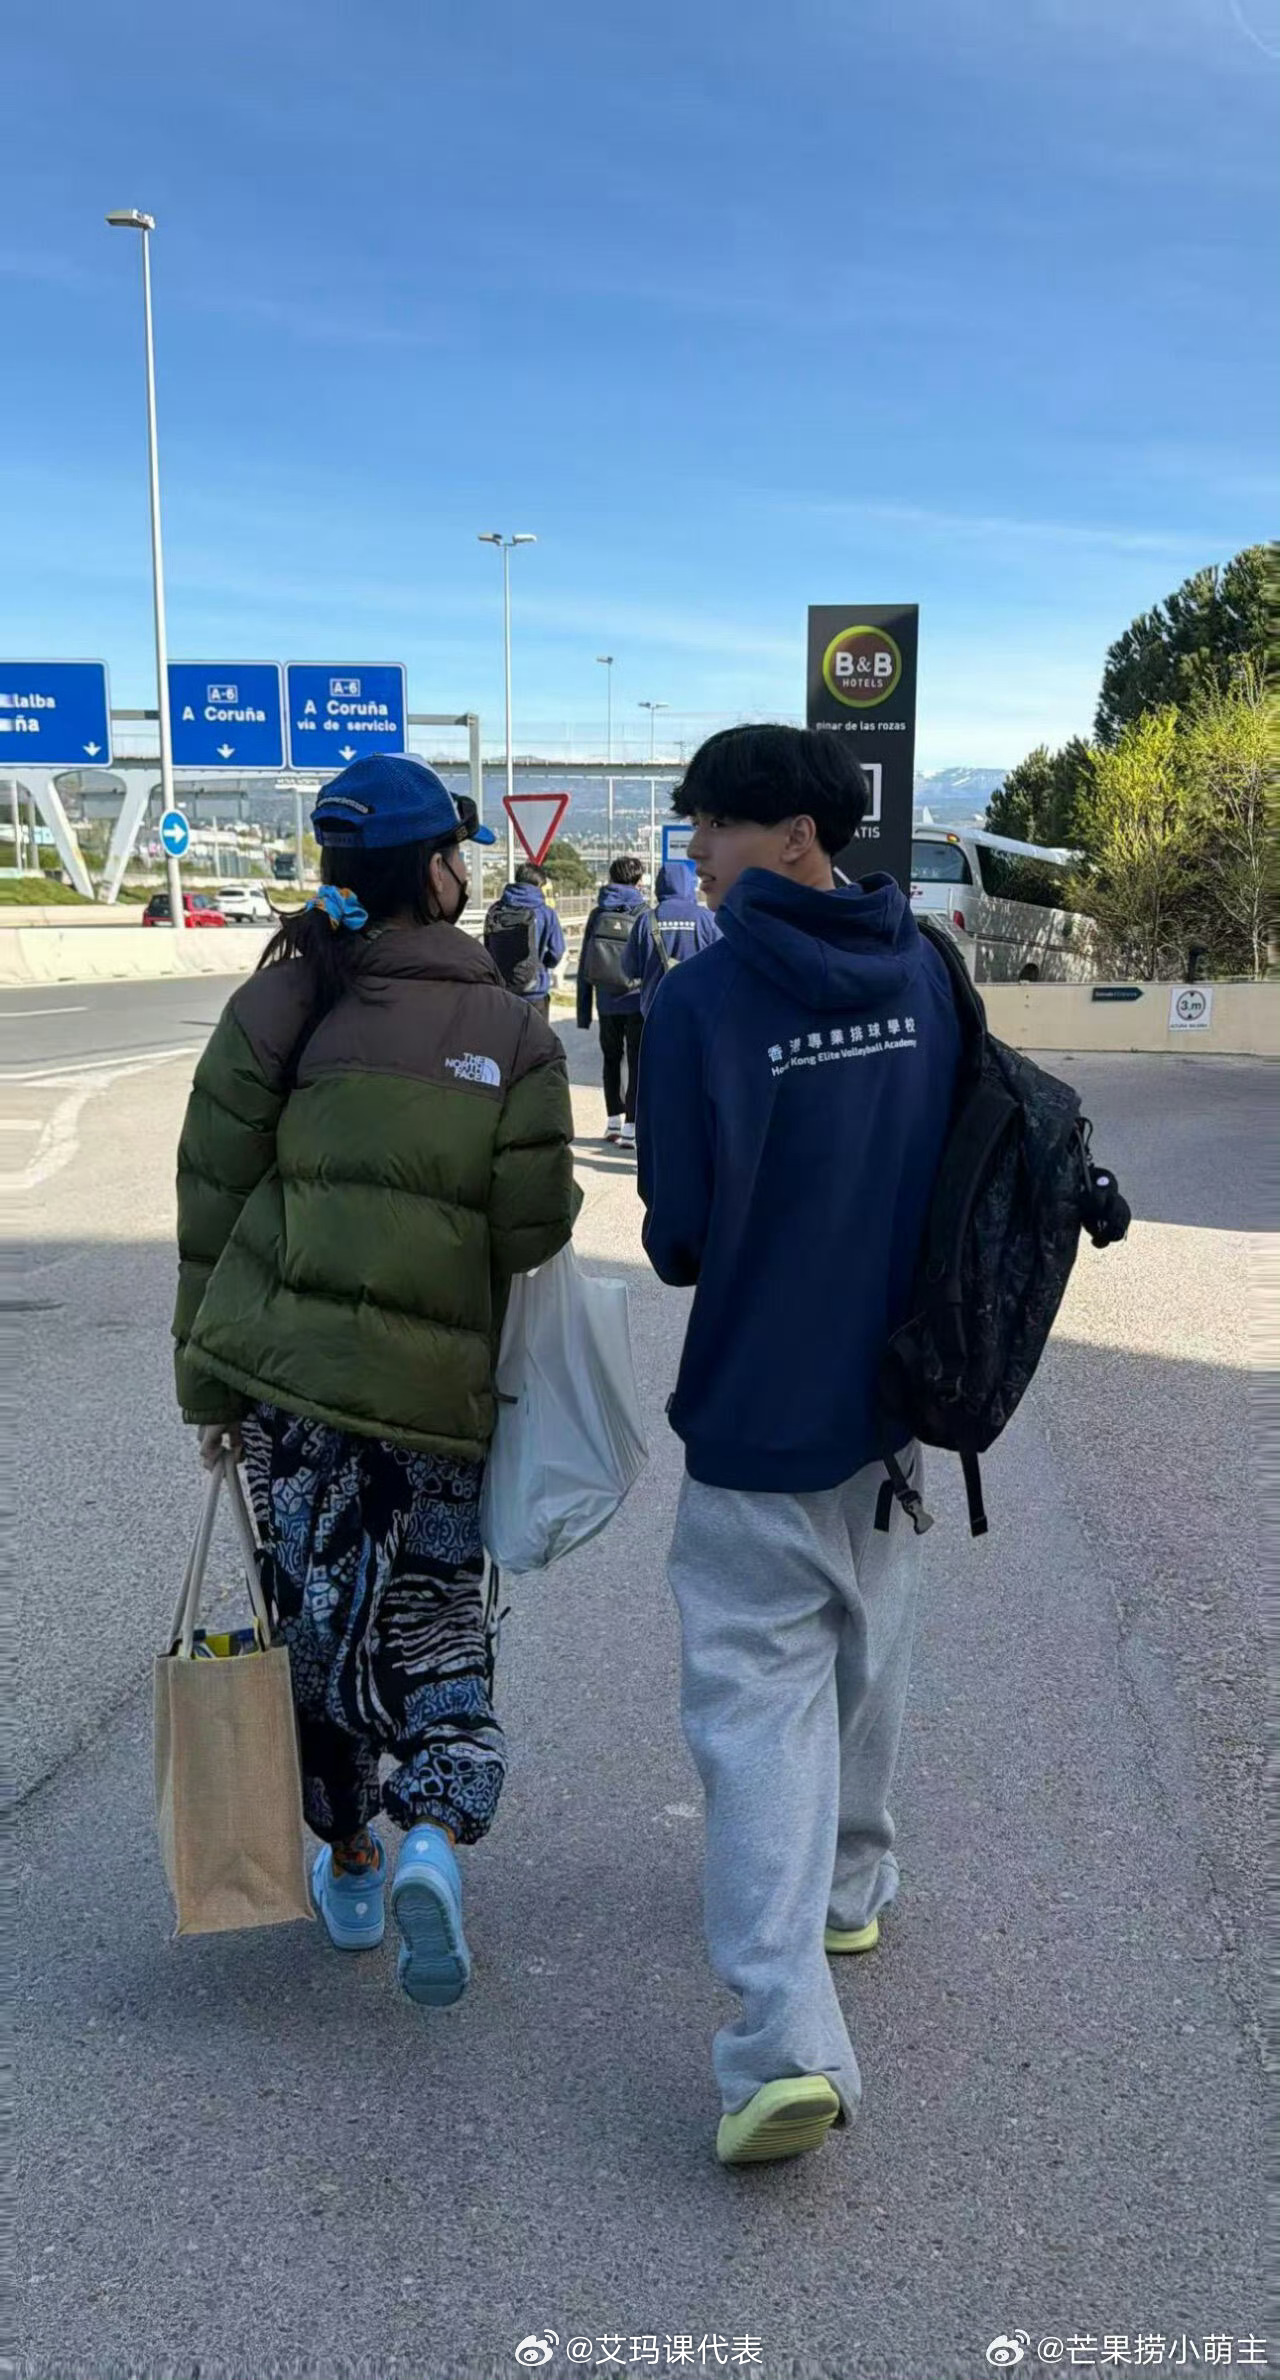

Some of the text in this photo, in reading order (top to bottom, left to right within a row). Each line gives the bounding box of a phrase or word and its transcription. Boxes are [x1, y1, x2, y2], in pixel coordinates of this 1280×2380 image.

[836, 651, 893, 677] B&B
[332, 681, 358, 694] A-6
[842, 678, 884, 688] HOTELS
[211, 687, 236, 700] A-6
[182, 705, 266, 722] A Coruña
[304, 699, 389, 716] A Coruña
[323, 719, 340, 731] de
[346, 720, 398, 732] servicio
[844, 721, 858, 731] de
[860, 721, 876, 731] las
[878, 722, 906, 731] rozas
[853, 826, 880, 839] ATIS
[463, 1052, 486, 1064] THE
[790, 1055, 817, 1067] Kong
[817, 1051, 841, 1062] Elite
[840, 1042, 884, 1058] Volleyball
[884, 1038, 917, 1050] Academy
[454, 1067, 482, 1081] FACE
